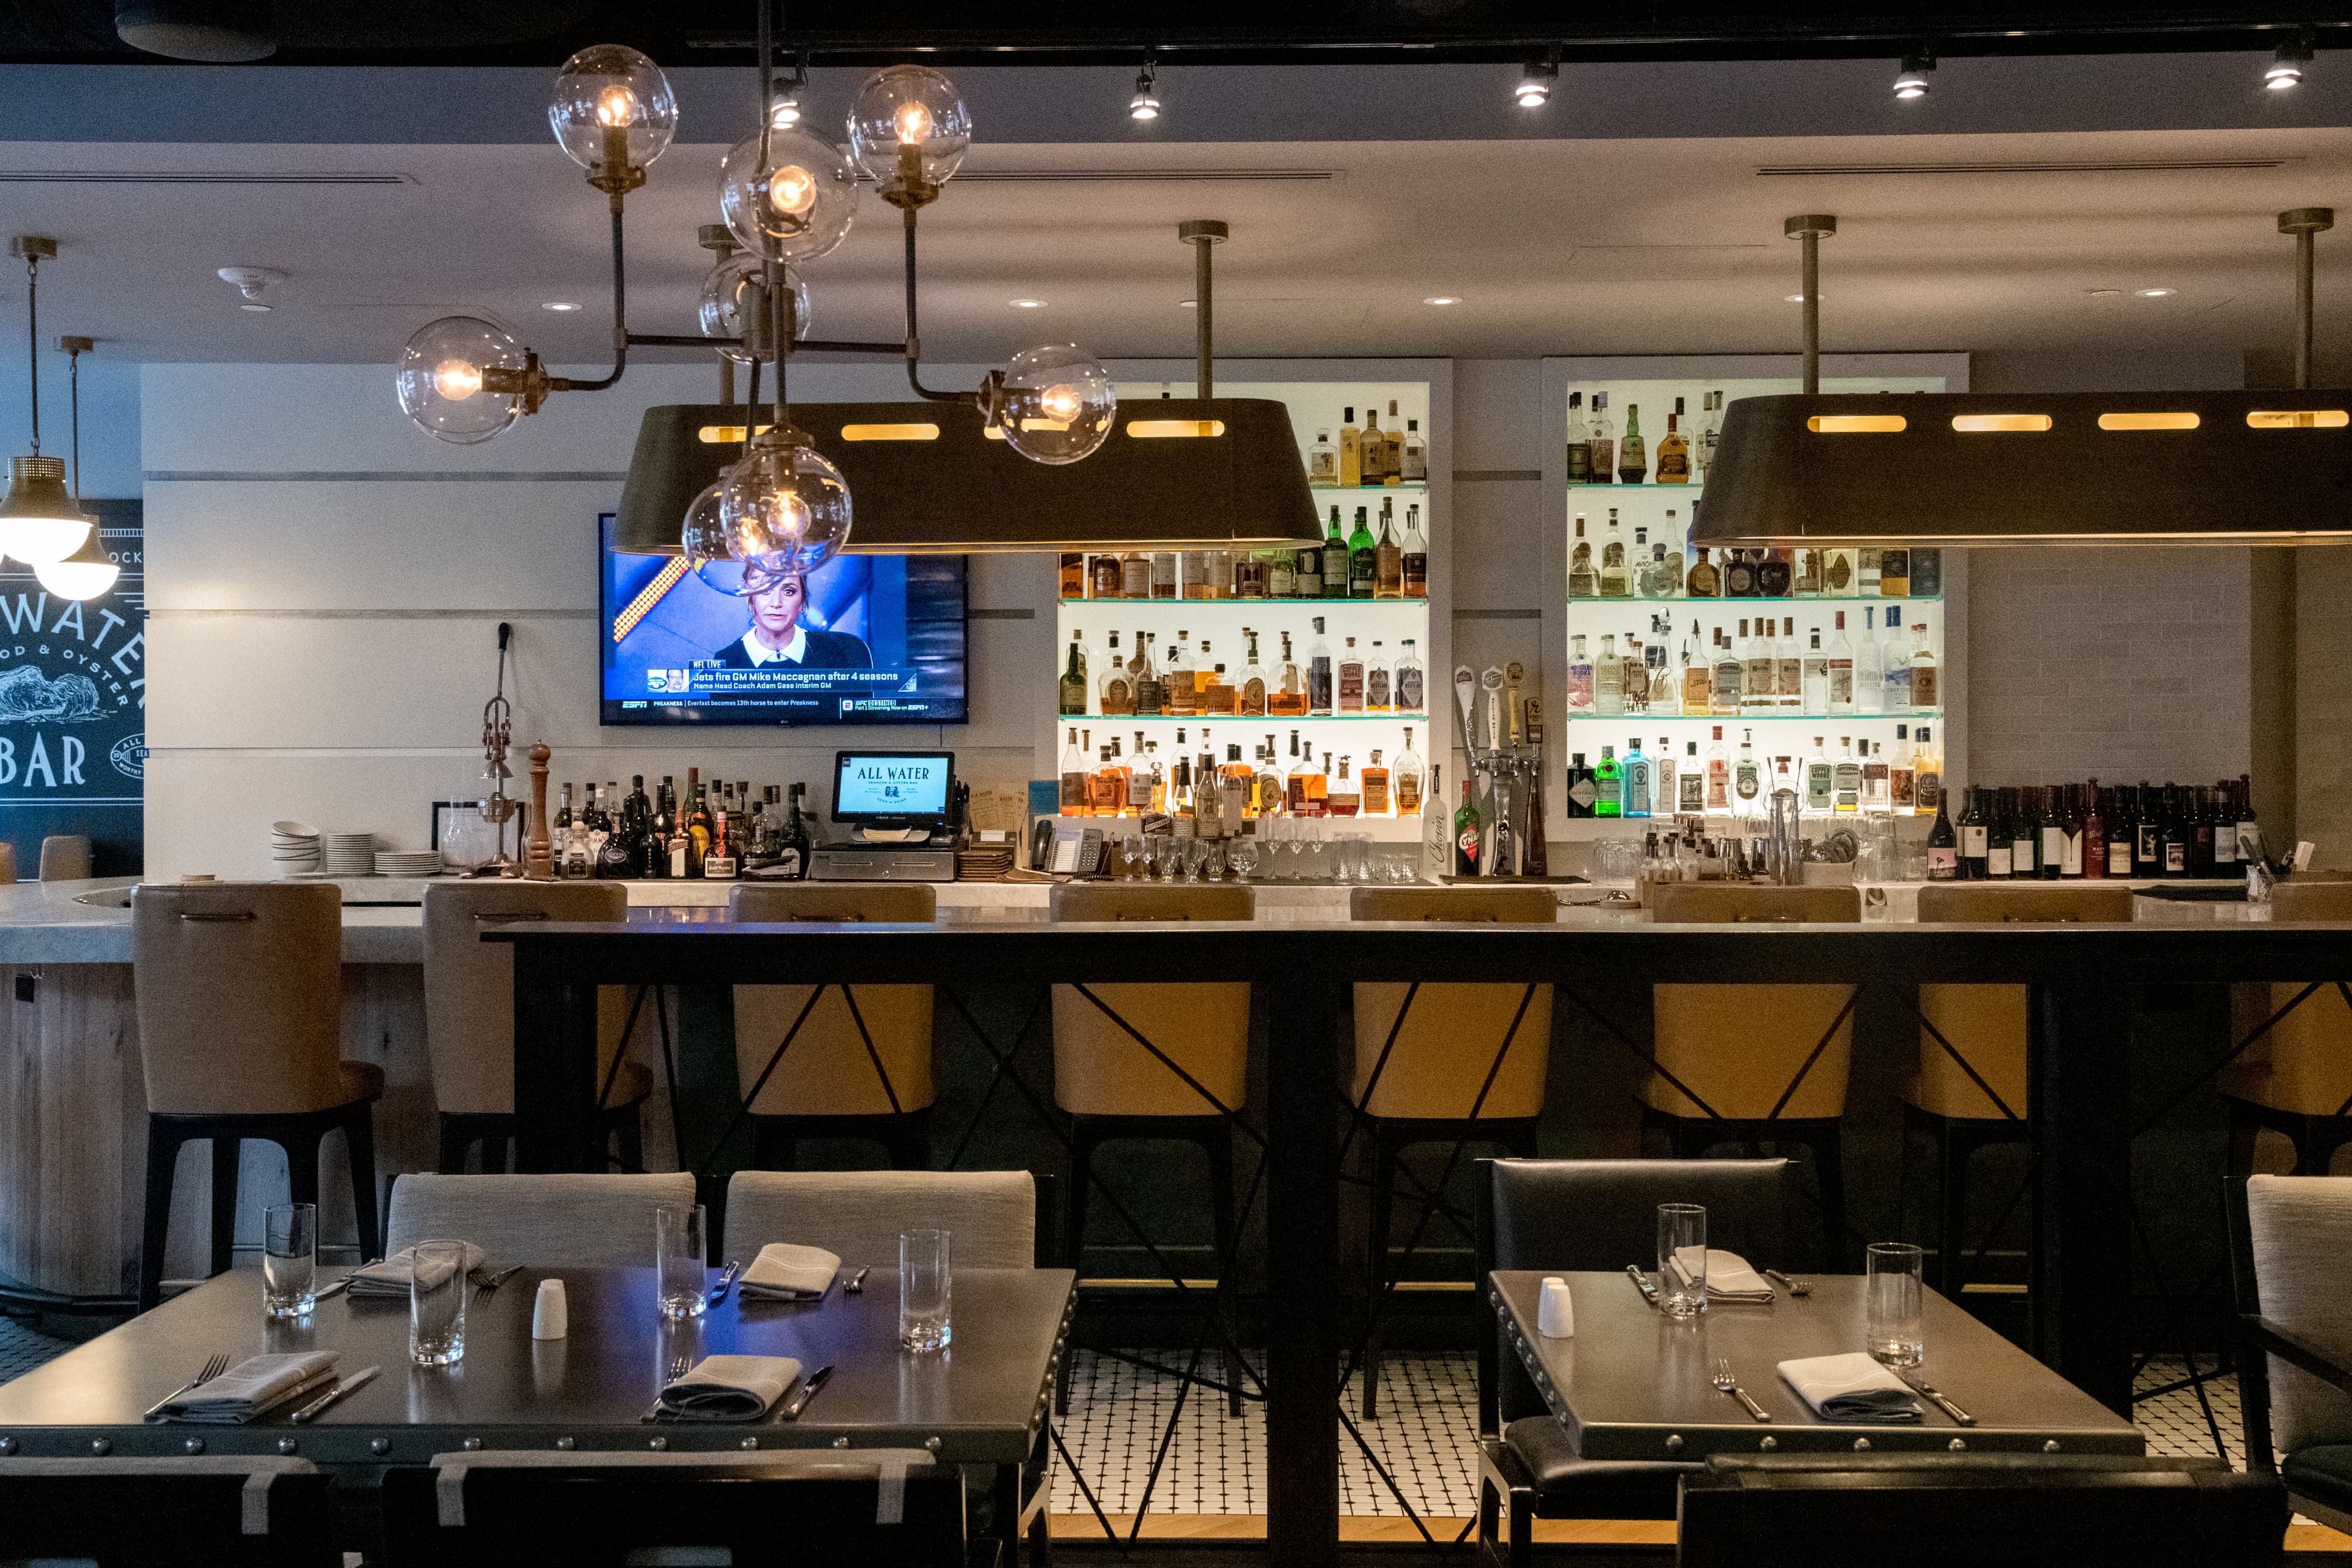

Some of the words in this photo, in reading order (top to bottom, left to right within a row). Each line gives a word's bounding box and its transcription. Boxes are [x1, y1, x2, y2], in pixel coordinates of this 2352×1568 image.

[39, 644, 50, 654] &
[63, 650, 128, 706] OYSTER
[715, 673, 731, 681] fire
[749, 673, 771, 681] Mike
[772, 673, 826, 683] Maccagnan
[828, 673, 850, 681] after
[123, 738, 141, 749] ALL
[0, 732, 86, 787] BAR
[119, 762, 141, 775] WORTHY
[858, 767, 883, 780] ALL
[888, 767, 930, 780] WATER
[1428, 813, 1446, 862] Chopin
